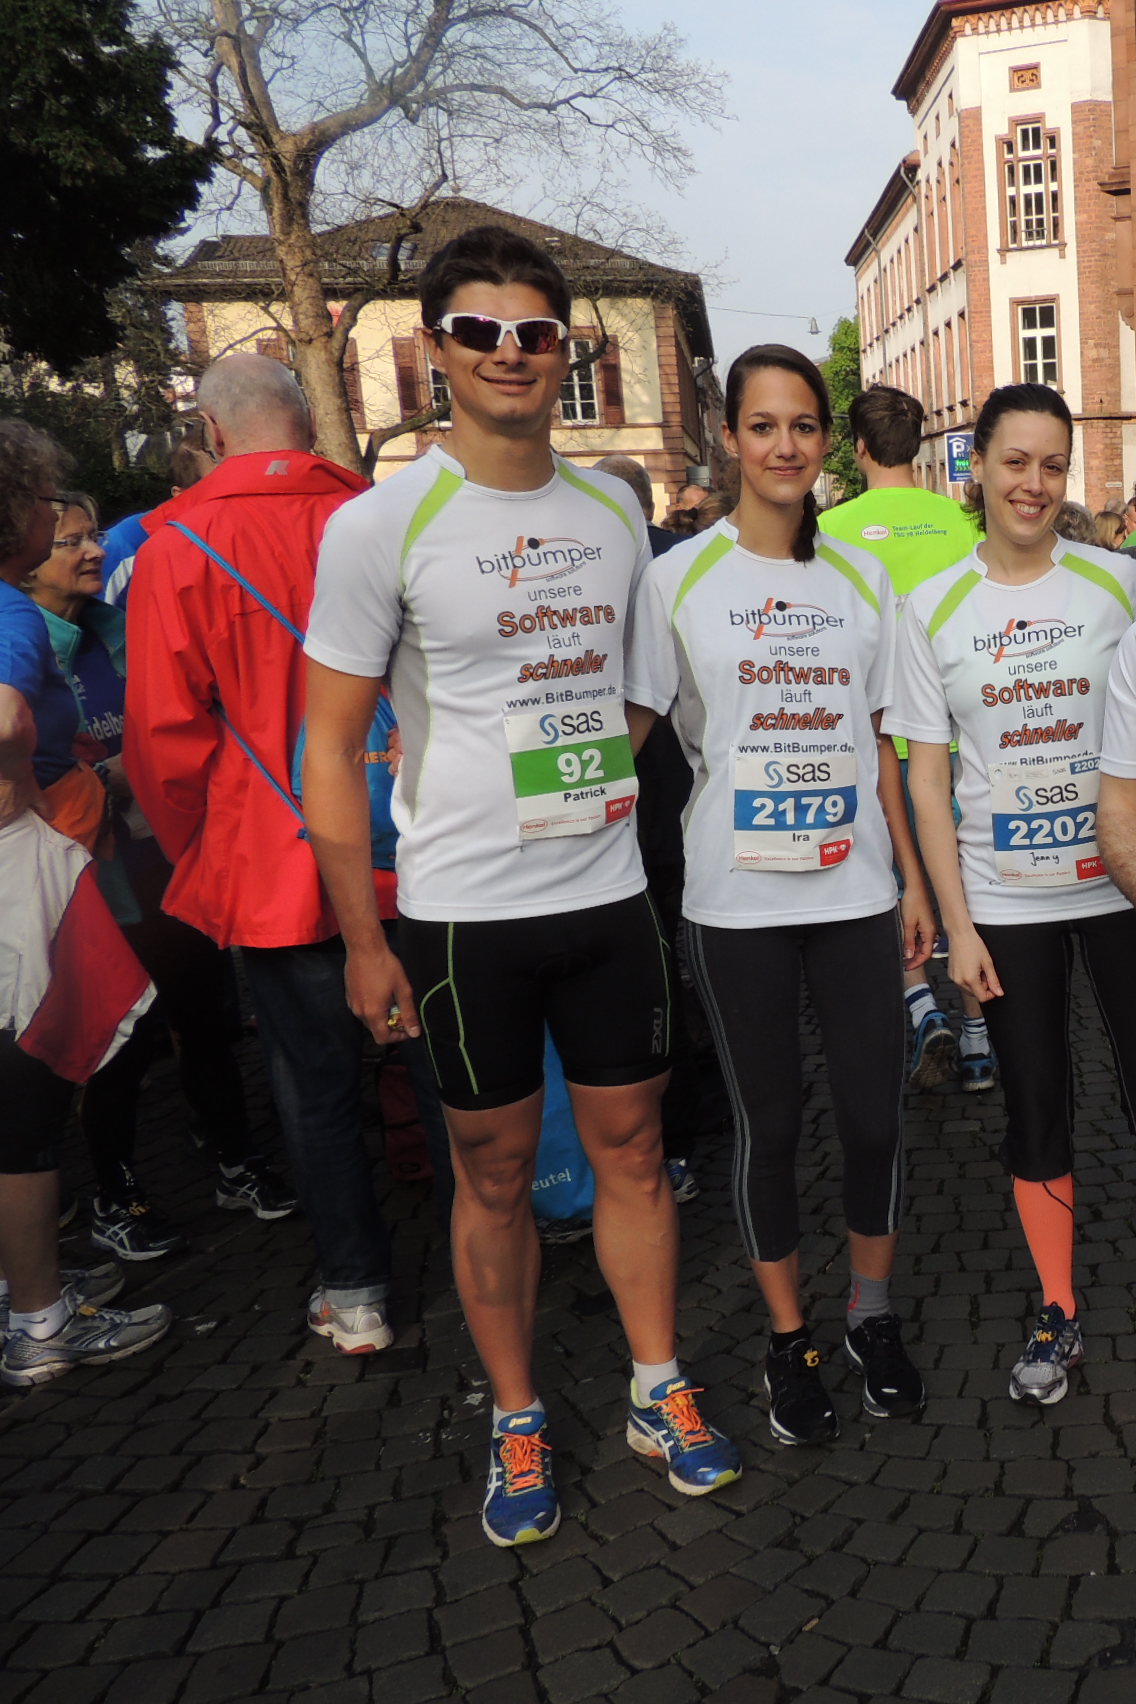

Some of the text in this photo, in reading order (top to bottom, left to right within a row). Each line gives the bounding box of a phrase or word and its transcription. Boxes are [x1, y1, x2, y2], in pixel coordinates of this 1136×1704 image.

[476, 545, 603, 576] bitbumper
[528, 584, 583, 602] unsere
[497, 602, 616, 637] Software
[729, 609, 845, 630] bitbumper
[547, 632, 582, 649] läuft
[973, 623, 1085, 652] bitbumper
[769, 644, 820, 657] unsere
[517, 649, 607, 683] schneller
[738, 660, 850, 685] Software
[1008, 659, 1058, 676] unsere
[505, 685, 616, 710] www.BitBumper.de
[780, 689, 812, 703] läuft
[981, 677, 1090, 707] Software
[561, 710, 603, 737] sas
[749, 707, 843, 731] schneller
[1023, 704, 1053, 719] läuft
[999, 719, 1084, 749] schneller
[738, 742, 854, 755] www.BitBumper.de
[557, 748, 604, 783] 92
[786, 762, 831, 784] sas
[564, 786, 606, 802] Patrick
[1035, 782, 1079, 806] sas
[752, 795, 845, 826] 2179
[792, 832, 810, 843] Ira
[1008, 811, 1096, 846] 2202
[531, 1168, 573, 1193] eutel
